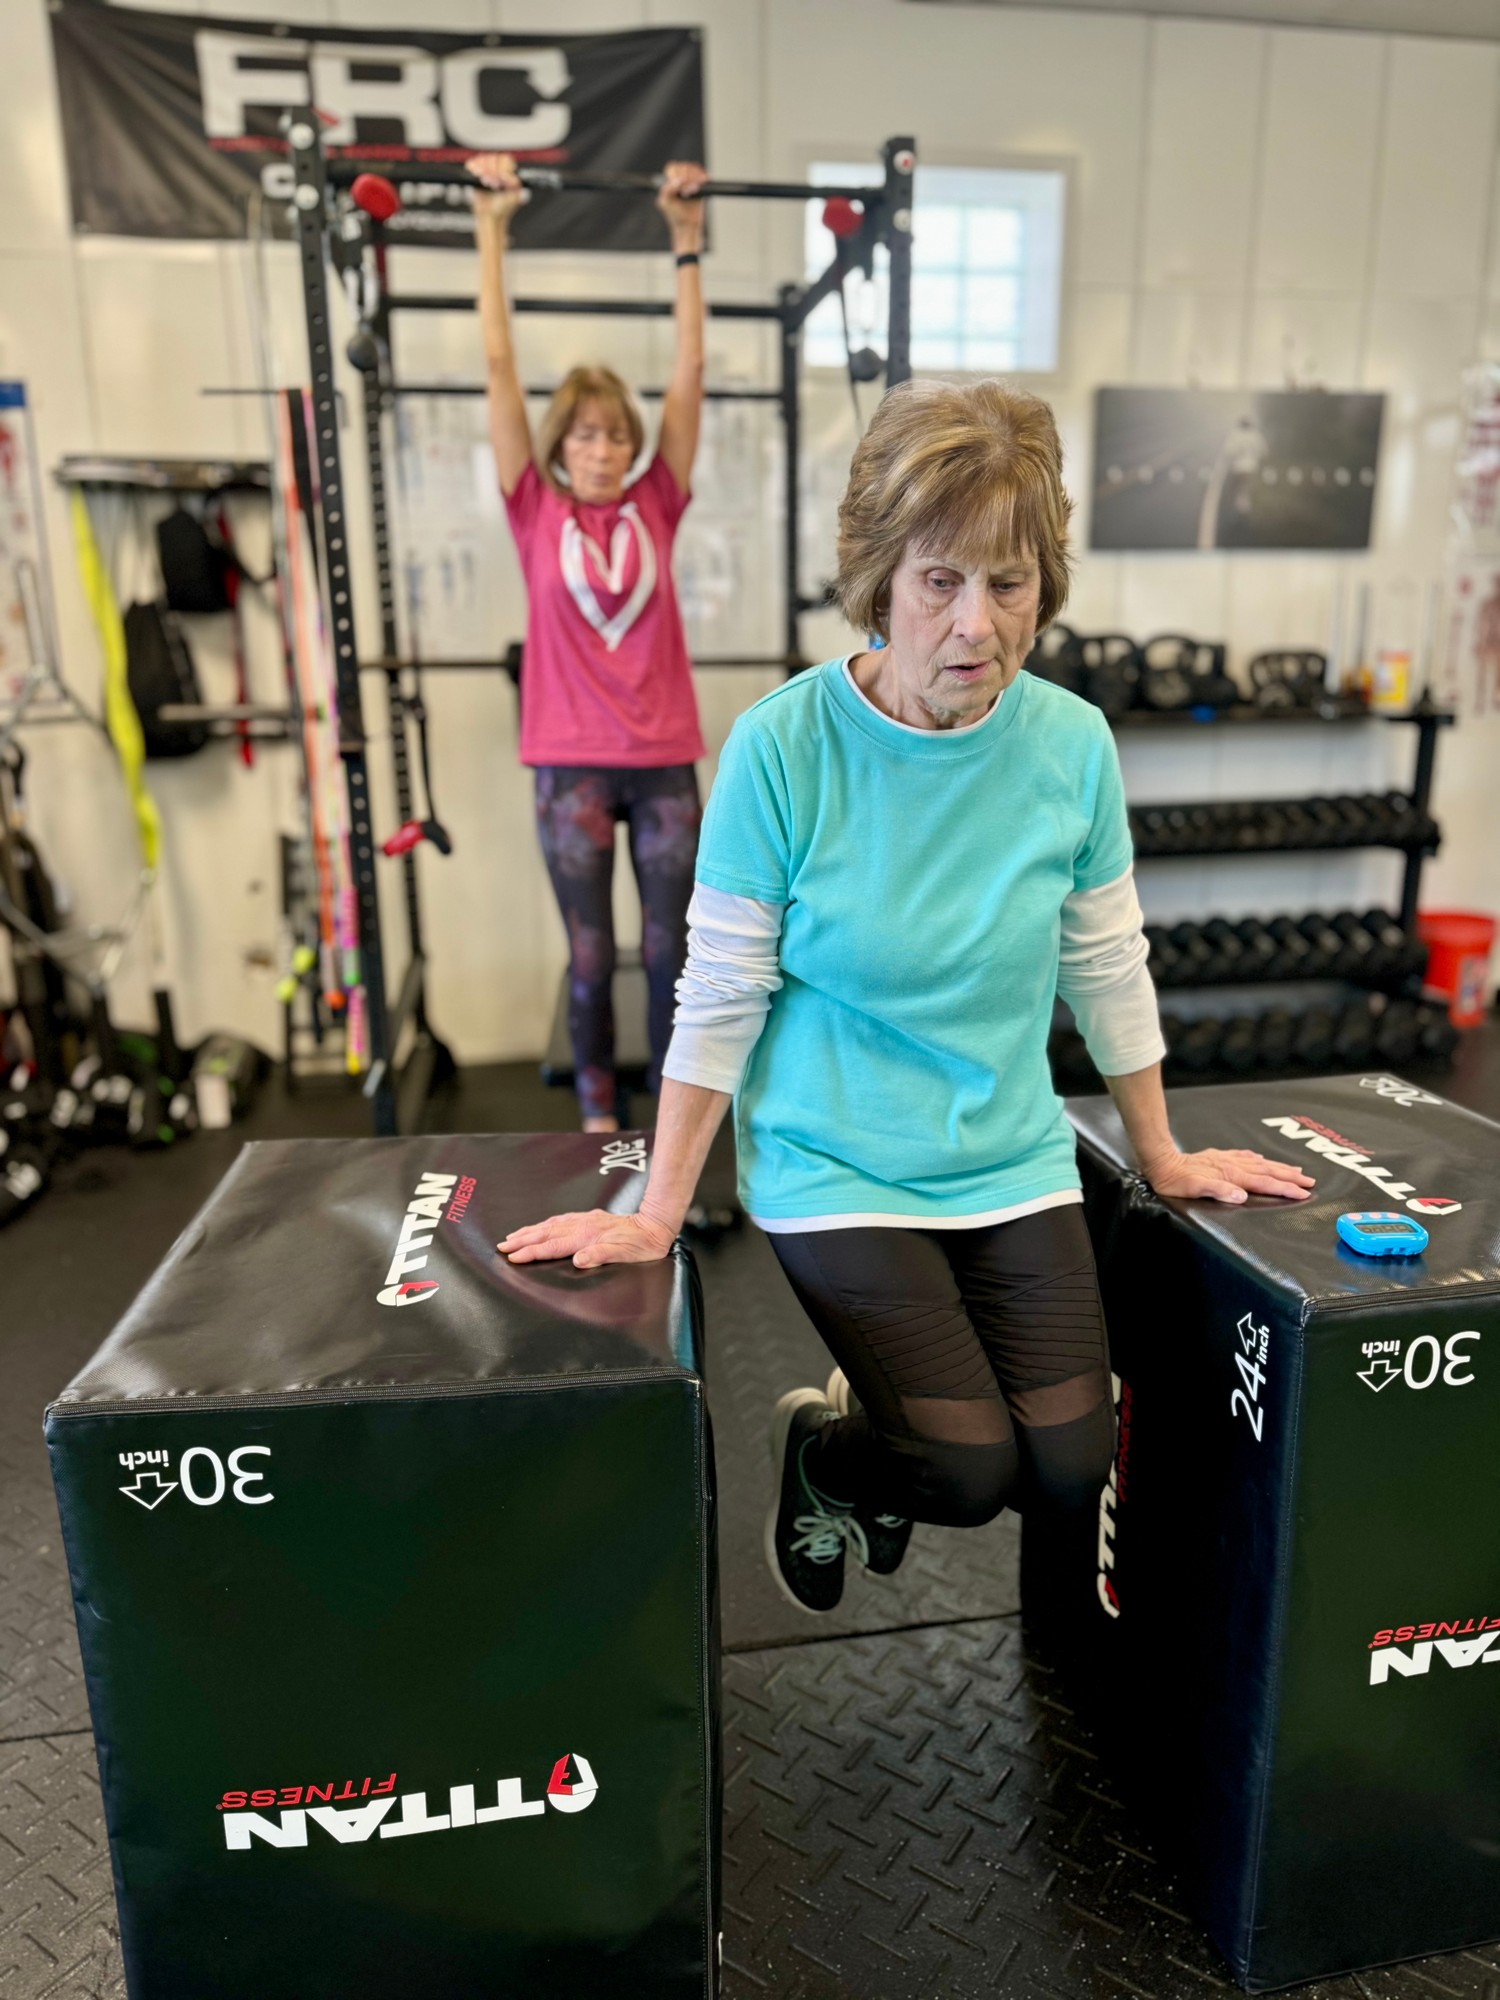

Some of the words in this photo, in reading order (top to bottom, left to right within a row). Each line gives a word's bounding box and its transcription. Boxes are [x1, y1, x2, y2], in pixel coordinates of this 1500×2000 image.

[194, 30, 571, 150] FRC
[599, 1149, 647, 1175] 20
[1261, 1116, 1416, 1200] TITAN
[384, 1172, 458, 1286] TITAN
[446, 1175, 477, 1224] FITNESS
[1361, 1340, 1401, 1359] inch
[1403, 1330, 1481, 1390] 30
[1231, 1351, 1267, 1442] 24
[1257, 1324, 1270, 1365] inch
[118, 1449, 170, 1471] inch
[179, 1445, 275, 1506] 30
[221, 1772, 397, 1809] FITNESS
[222, 1776, 546, 1851] TITAN
